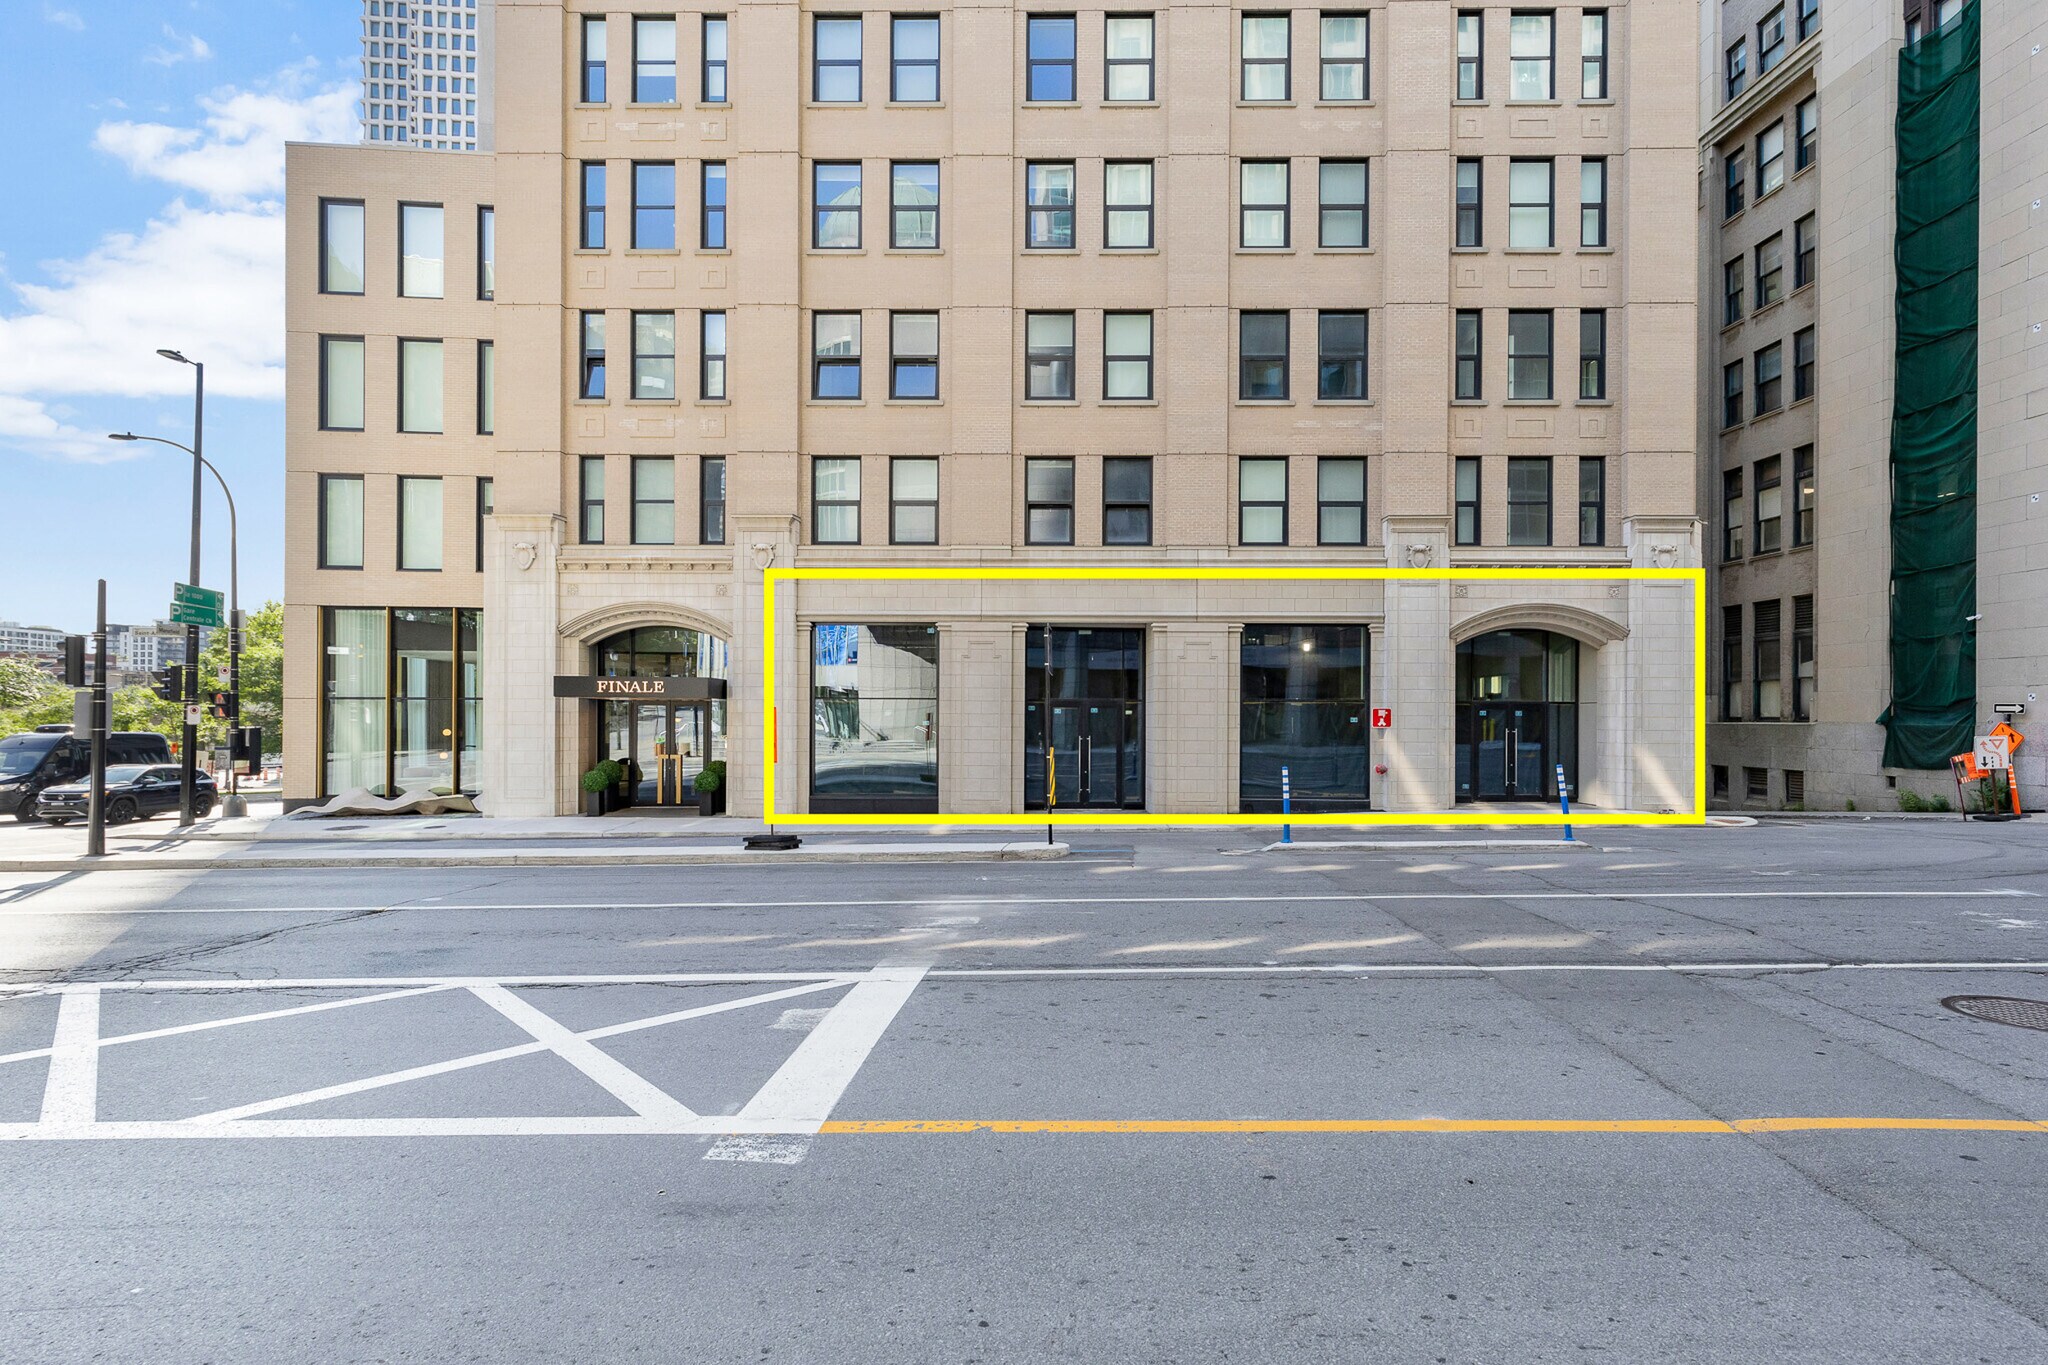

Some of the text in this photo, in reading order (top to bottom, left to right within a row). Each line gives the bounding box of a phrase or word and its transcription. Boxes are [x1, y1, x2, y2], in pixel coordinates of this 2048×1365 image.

[175, 585, 183, 599] P
[171, 606, 181, 620] P
[183, 615, 204, 623] Centrale
[597, 681, 664, 693] FINALE
